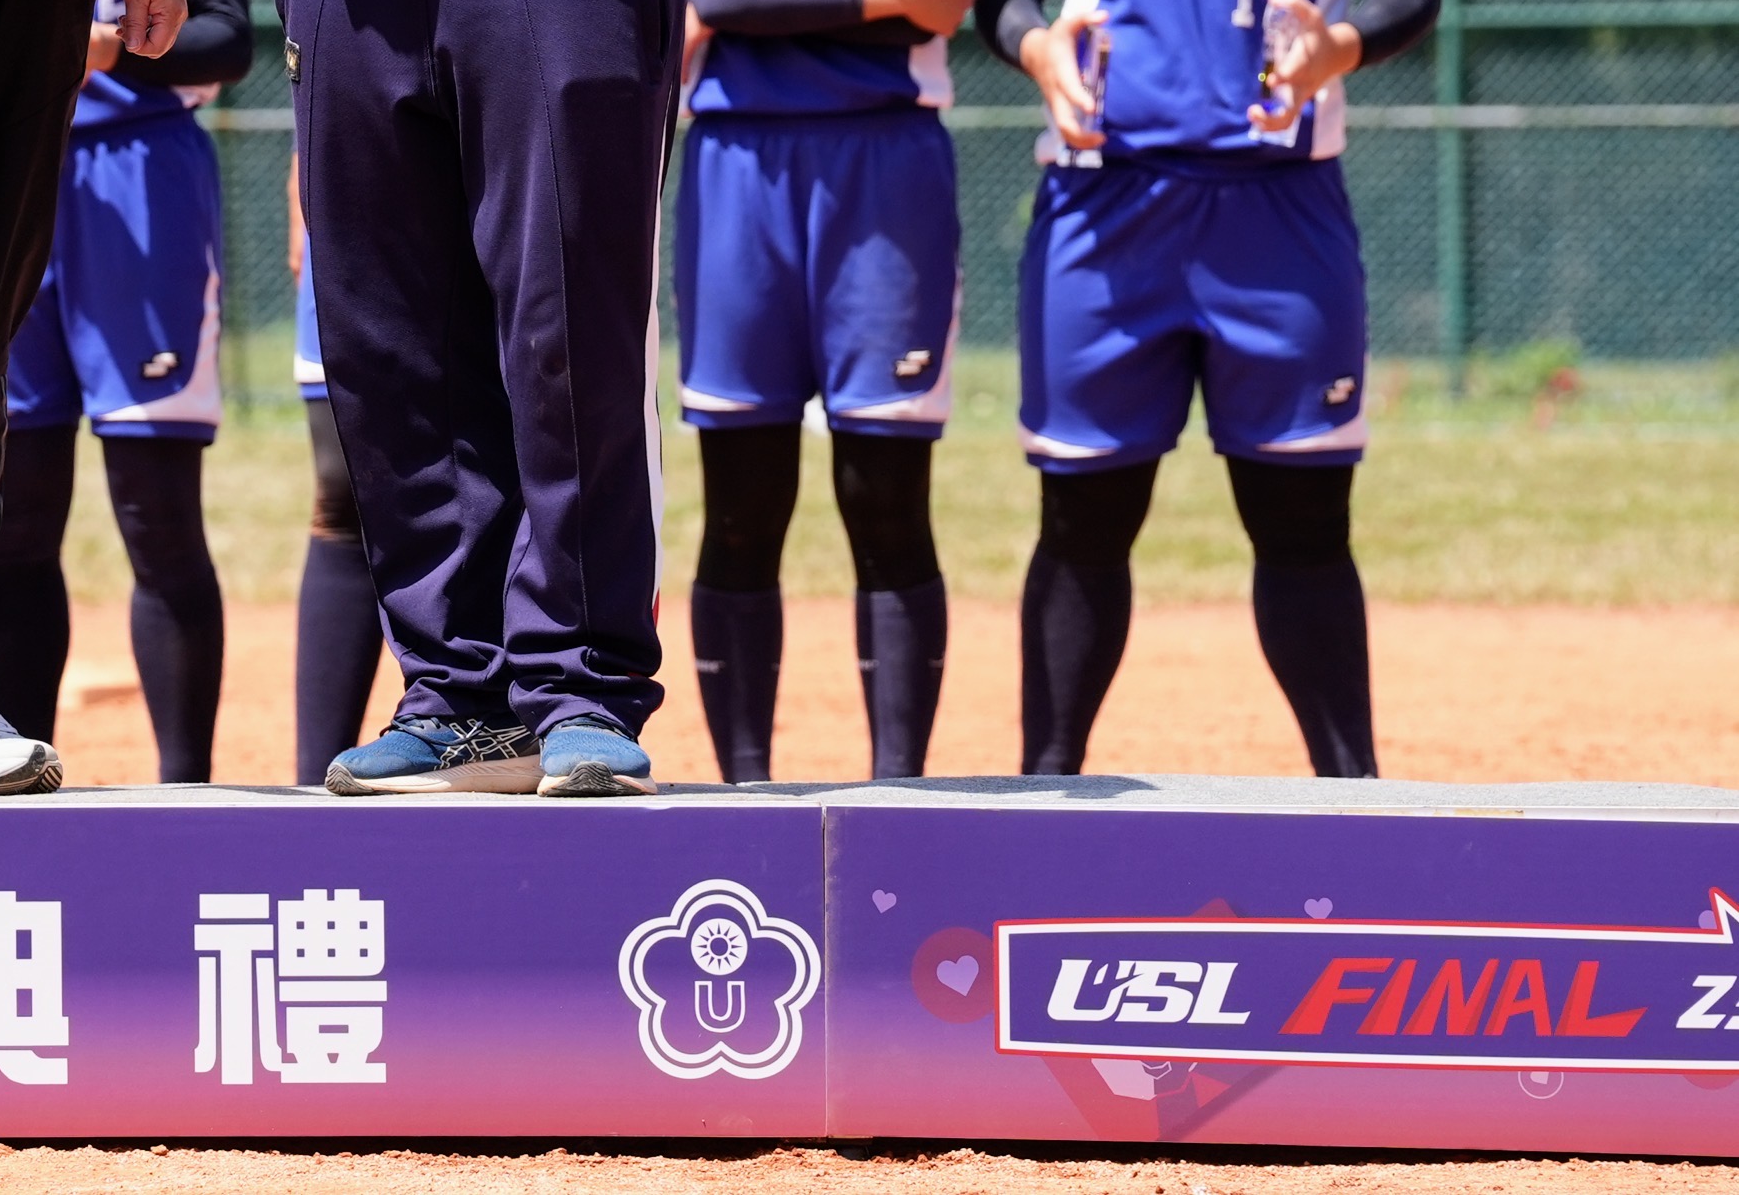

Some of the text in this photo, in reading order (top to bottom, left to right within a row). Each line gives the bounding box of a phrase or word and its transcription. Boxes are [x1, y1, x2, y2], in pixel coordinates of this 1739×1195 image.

[1046, 957, 1739, 1038] USL FINAL 2
